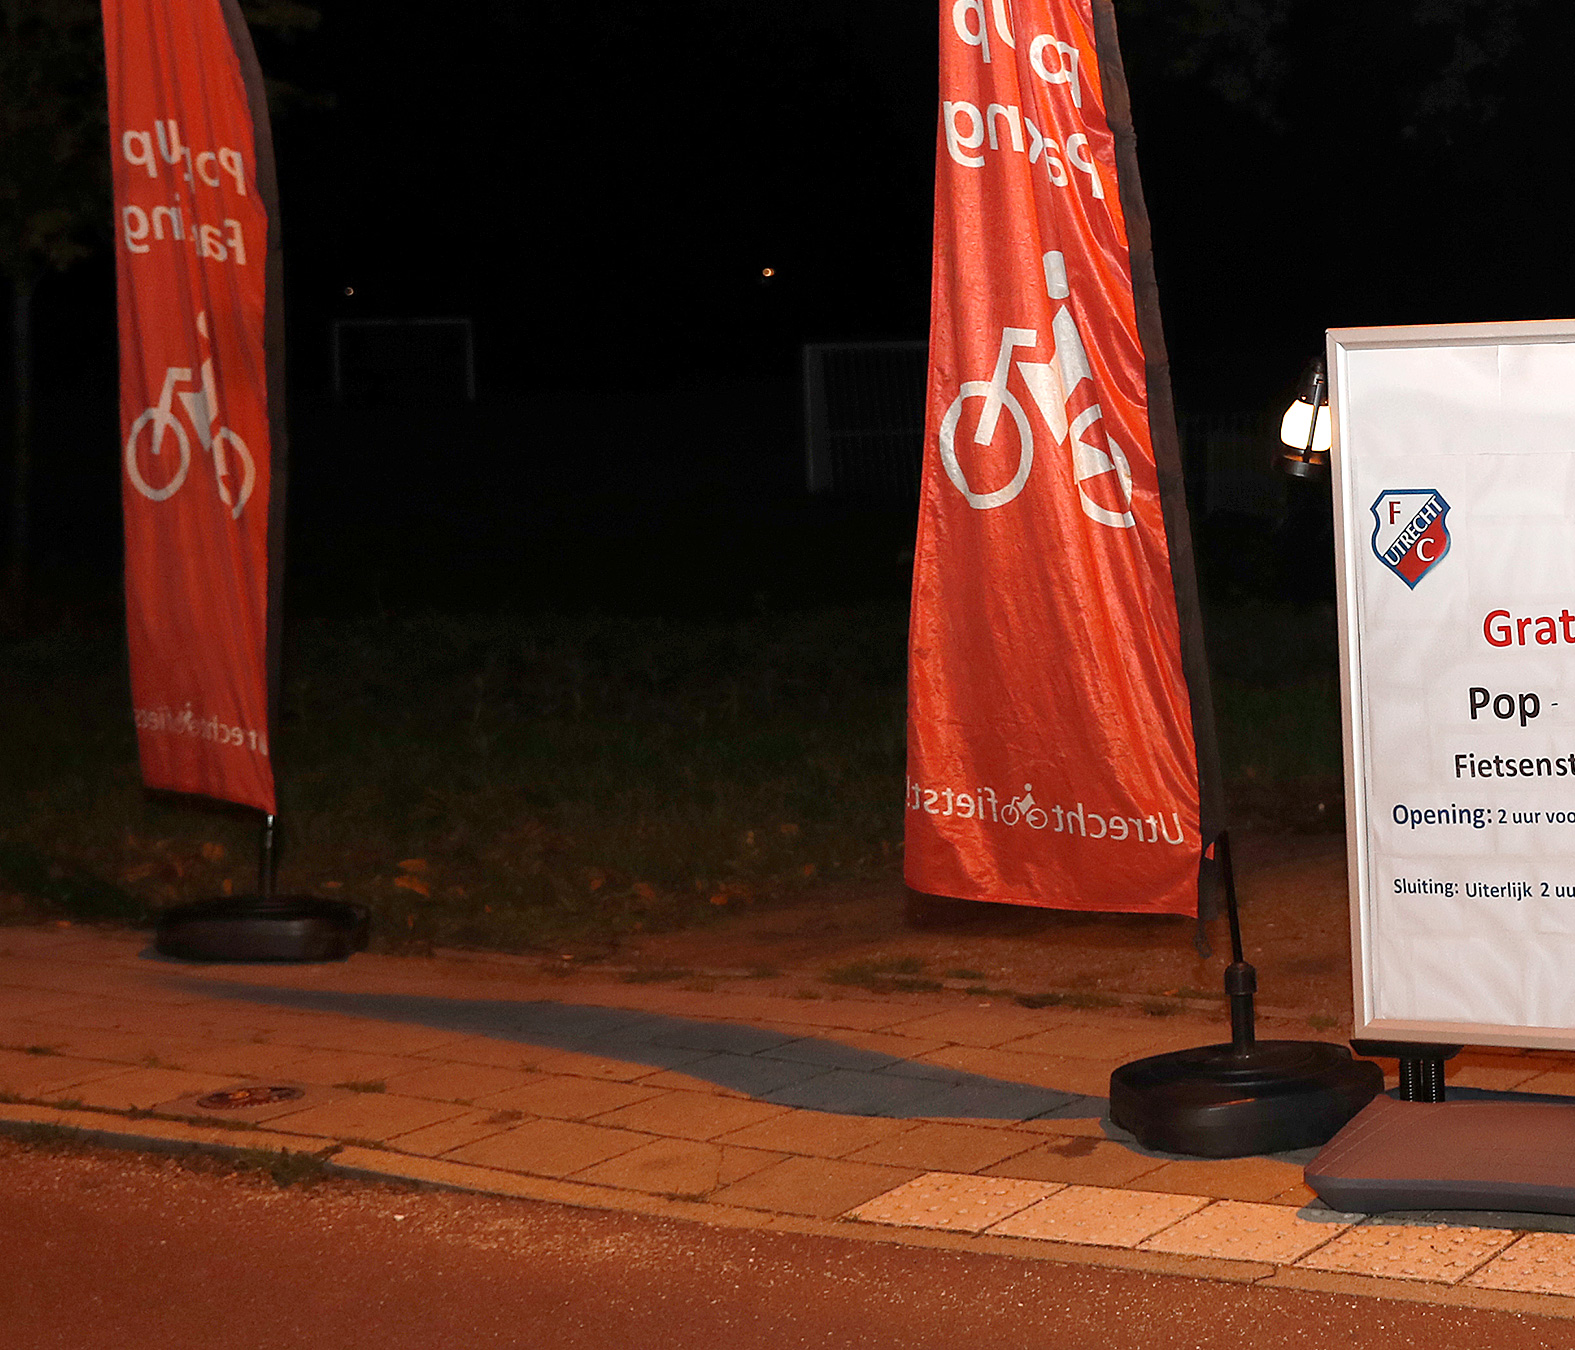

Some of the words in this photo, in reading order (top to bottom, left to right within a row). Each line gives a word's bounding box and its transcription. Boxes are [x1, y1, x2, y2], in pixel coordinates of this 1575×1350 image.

[1389, 501, 1401, 525] F
[1384, 495, 1443, 567] UTRECHT
[1416, 537, 1435, 562] C
[1469, 687, 1541, 727] Pop
[1392, 804, 1493, 830] Opening:
[1497, 808, 1508, 824] 2
[1512, 812, 1541, 824] uur
[1393, 878, 1459, 898] Sluiting:
[1465, 881, 1533, 901] Uiterlijk
[1540, 882, 1550, 898] 2
